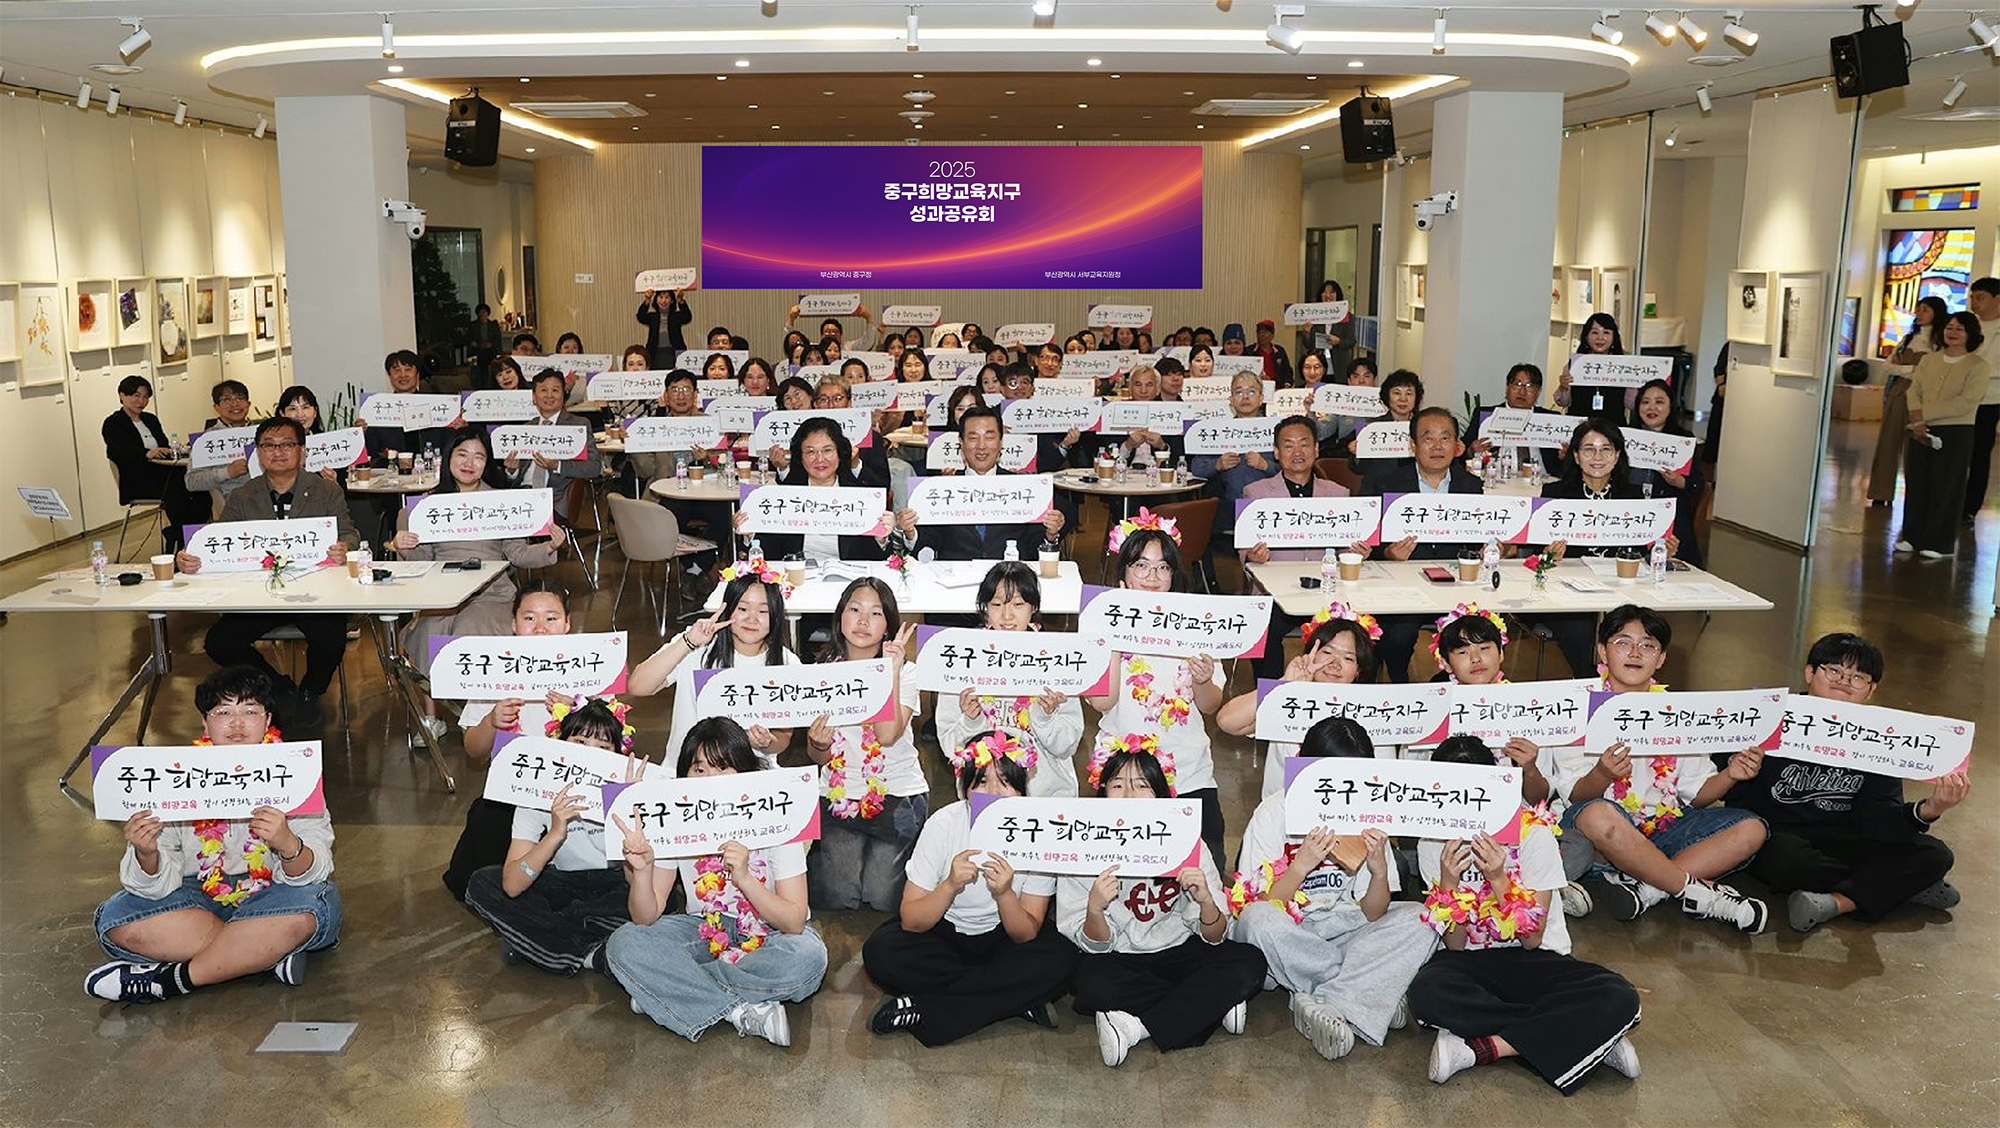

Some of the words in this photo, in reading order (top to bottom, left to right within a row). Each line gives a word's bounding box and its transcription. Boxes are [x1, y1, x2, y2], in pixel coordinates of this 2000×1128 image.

[929, 161, 976, 178] 2025
[884, 182, 1021, 200] 중구희망교육지구
[909, 205, 995, 222] 성과공유회
[1045, 271, 1076, 279] 부산광역시
[1077, 271, 1121, 279] 서부교육지원청
[1014, 408, 1034, 420] 중구
[1036, 406, 1089, 419] 희망교육지구
[769, 421, 790, 436] 중구
[1198, 429, 1219, 441] 중구
[1222, 427, 1274, 439] 희망교육지
[204, 439, 226, 453] 중구
[500, 434, 519, 446] 중구
[521, 432, 574, 446] 희망교육지구
[1368, 432, 1387, 445] 중구
[926, 489, 955, 506] 중구
[958, 487, 1035, 505] 희망교육지구
[426, 508, 454, 525] 중구
[457, 502, 535, 521] 희망교육지구
[759, 499, 787, 515] 중구
[790, 497, 868, 516] 희망교육지구
[1401, 507, 1429, 524] 중구
[1433, 504, 1511, 525] 희망교육지구
[1254, 511, 1282, 529] 중구
[1285, 509, 1363, 528] 희망교육지구
[1548, 510, 1577, 528] 중구
[1582, 509, 1656, 529] 희망교육지구
[204, 537, 235, 553] 중구
[238, 531, 320, 550] 희망교육지구
[1104, 604, 1143, 628] 중구
[1148, 605, 1247, 636] 희망교육지구
[1141, 636, 1171, 646] 희망교육
[455, 653, 493, 676] 중구
[497, 650, 604, 676] 희망교육지구
[940, 644, 977, 668] 중구
[982, 643, 1087, 672] 희망교육지구
[720, 685, 759, 707] 중구
[762, 679, 869, 703] 희망교육지구
[761, 711, 791, 719] 희망교육
[838, 706, 868, 716] 교육도시
[1281, 697, 1320, 720] 중구
[1325, 696, 1429, 721] 희망교육지구
[1472, 697, 1579, 722] 희망교육지구
[1613, 707, 1654, 731] 중구
[1658, 704, 1762, 730] 희망교육지구
[1394, 726, 1423, 735] 교육도시
[1548, 726, 1577, 735] 교육도시
[1652, 736, 1682, 746] 희망교육
[1727, 733, 1757, 743] 교육도시
[1782, 710, 1817, 736] 중구
[1821, 714, 1941, 757] 희망교육지구
[512, 753, 546, 779] 중구
[1813, 744, 1846, 758] 희망교육
[1899, 758, 1934, 772] 교육도시
[117, 766, 161, 793] 중구
[165, 762, 293, 790] 희망교육지구
[254, 795, 290, 806] 교육도시
[1314, 778, 1358, 805] 중구
[1364, 775, 1491, 812] 희망교육지구
[629, 802, 671, 829] 중구
[675, 791, 793, 822] 희망교육지구
[998, 816, 1044, 843] 중구
[1048, 813, 1172, 846] 희망교육지구
[1358, 814, 1393, 824] 희망교육
[1449, 818, 1486, 830] 교육도시
[674, 833, 708, 845] 희망교육
[760, 824, 791, 836] 교육도시
[1043, 852, 1079, 862] 희망교육
[1133, 854, 1168, 864] 교육도시
[1329, 873, 1342, 888] 06
